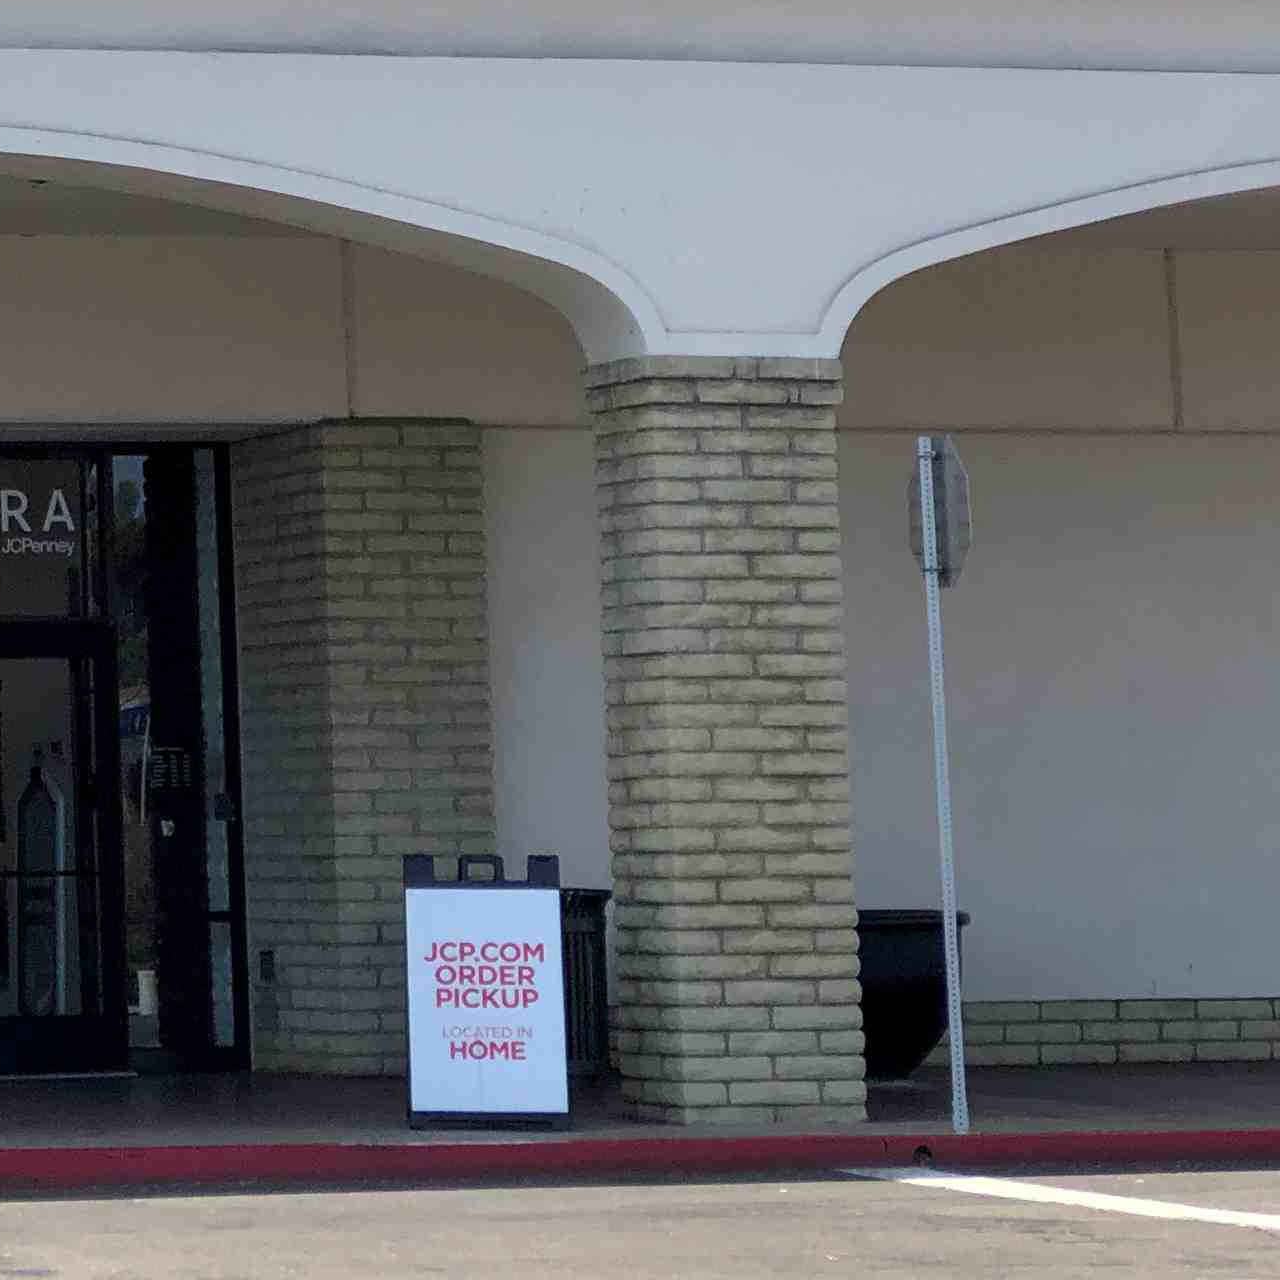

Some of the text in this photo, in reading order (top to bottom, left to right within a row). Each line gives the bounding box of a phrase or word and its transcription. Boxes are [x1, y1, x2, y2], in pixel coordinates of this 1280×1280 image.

[0, 538, 75, 556] JCPenney
[424, 942, 544, 962] JCP.COM
[435, 965, 535, 985] ORDER
[436, 988, 539, 1008] PICKUP
[442, 1026, 533, 1038] LOCATED IN
[450, 1040, 527, 1060] HOME
